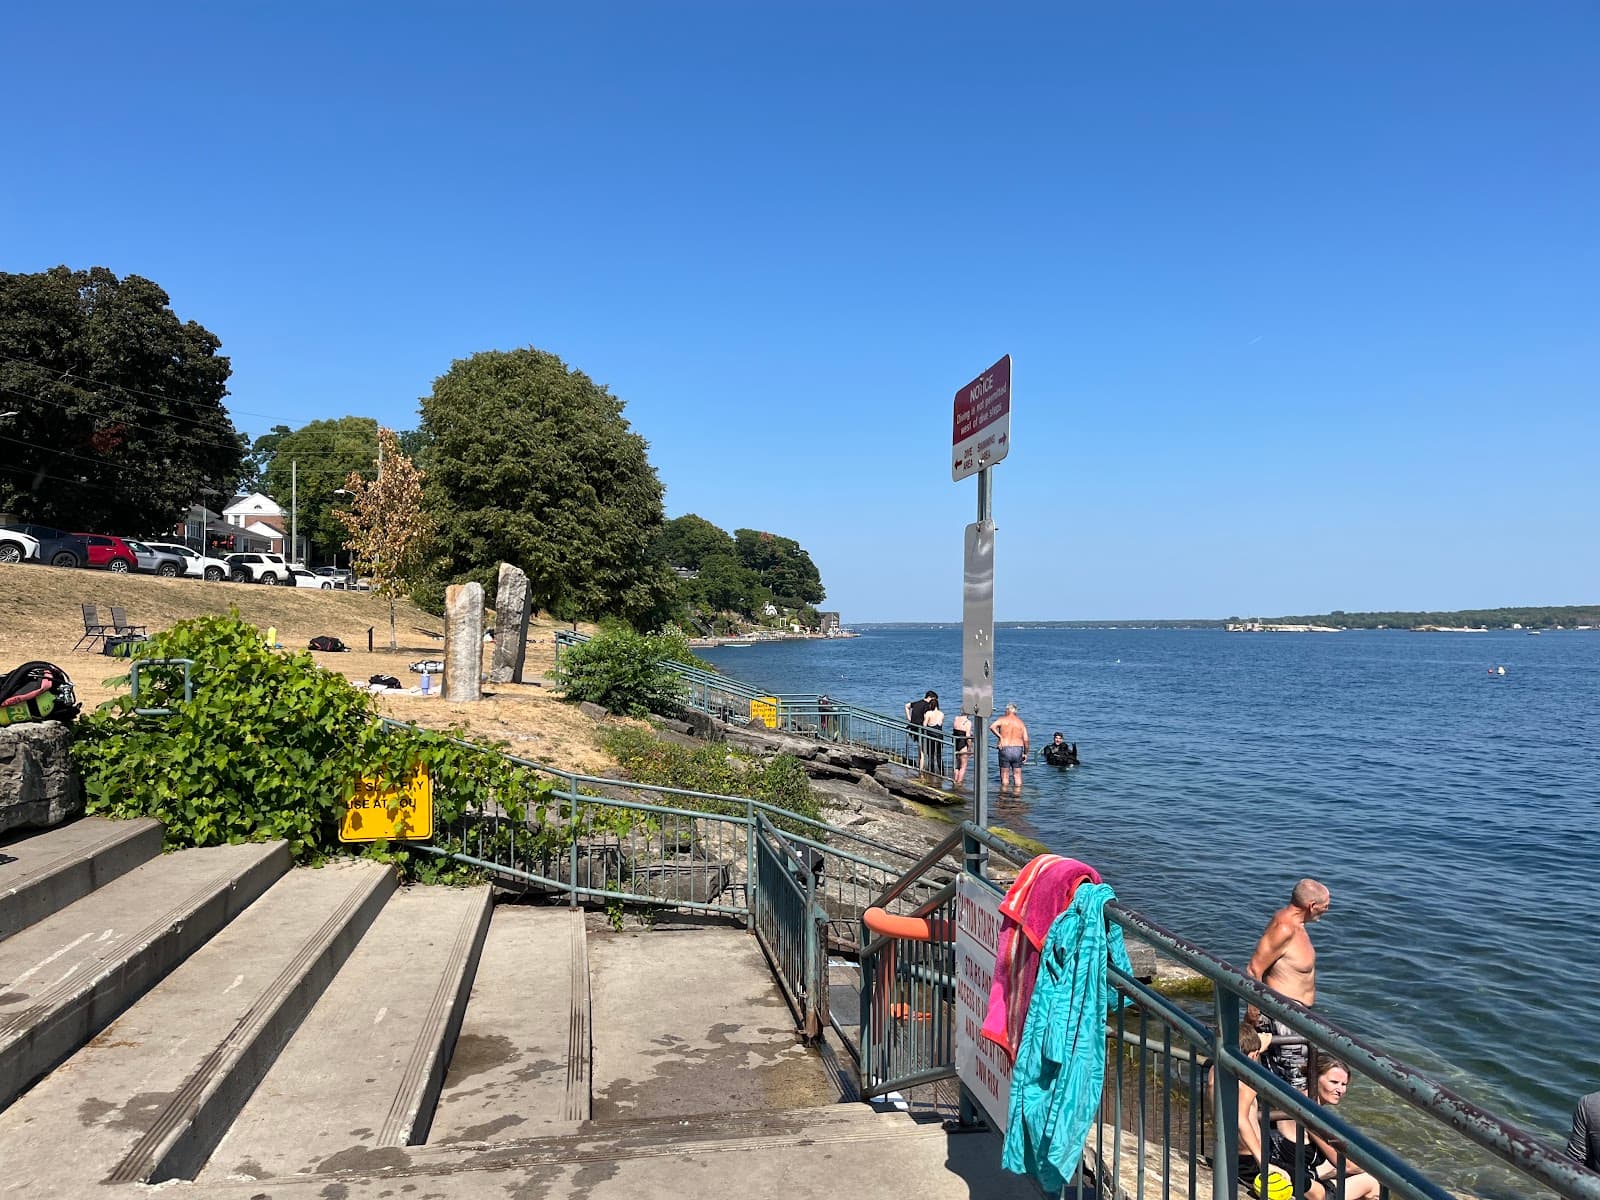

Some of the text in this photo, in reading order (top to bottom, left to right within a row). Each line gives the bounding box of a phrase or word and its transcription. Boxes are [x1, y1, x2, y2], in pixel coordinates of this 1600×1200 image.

[970, 374, 993, 403] NOTICE
[374, 800, 387, 809] AT
[399, 799, 417, 809] OU
[957, 891, 977, 936] CTION
[978, 905, 995, 950] STAIRS
[965, 954, 980, 988] STARS
[958, 977, 974, 1013] ACCESS
[976, 994, 981, 1018] IS
[966, 1015, 975, 1041] AND
[988, 1068, 999, 1102] RISK
